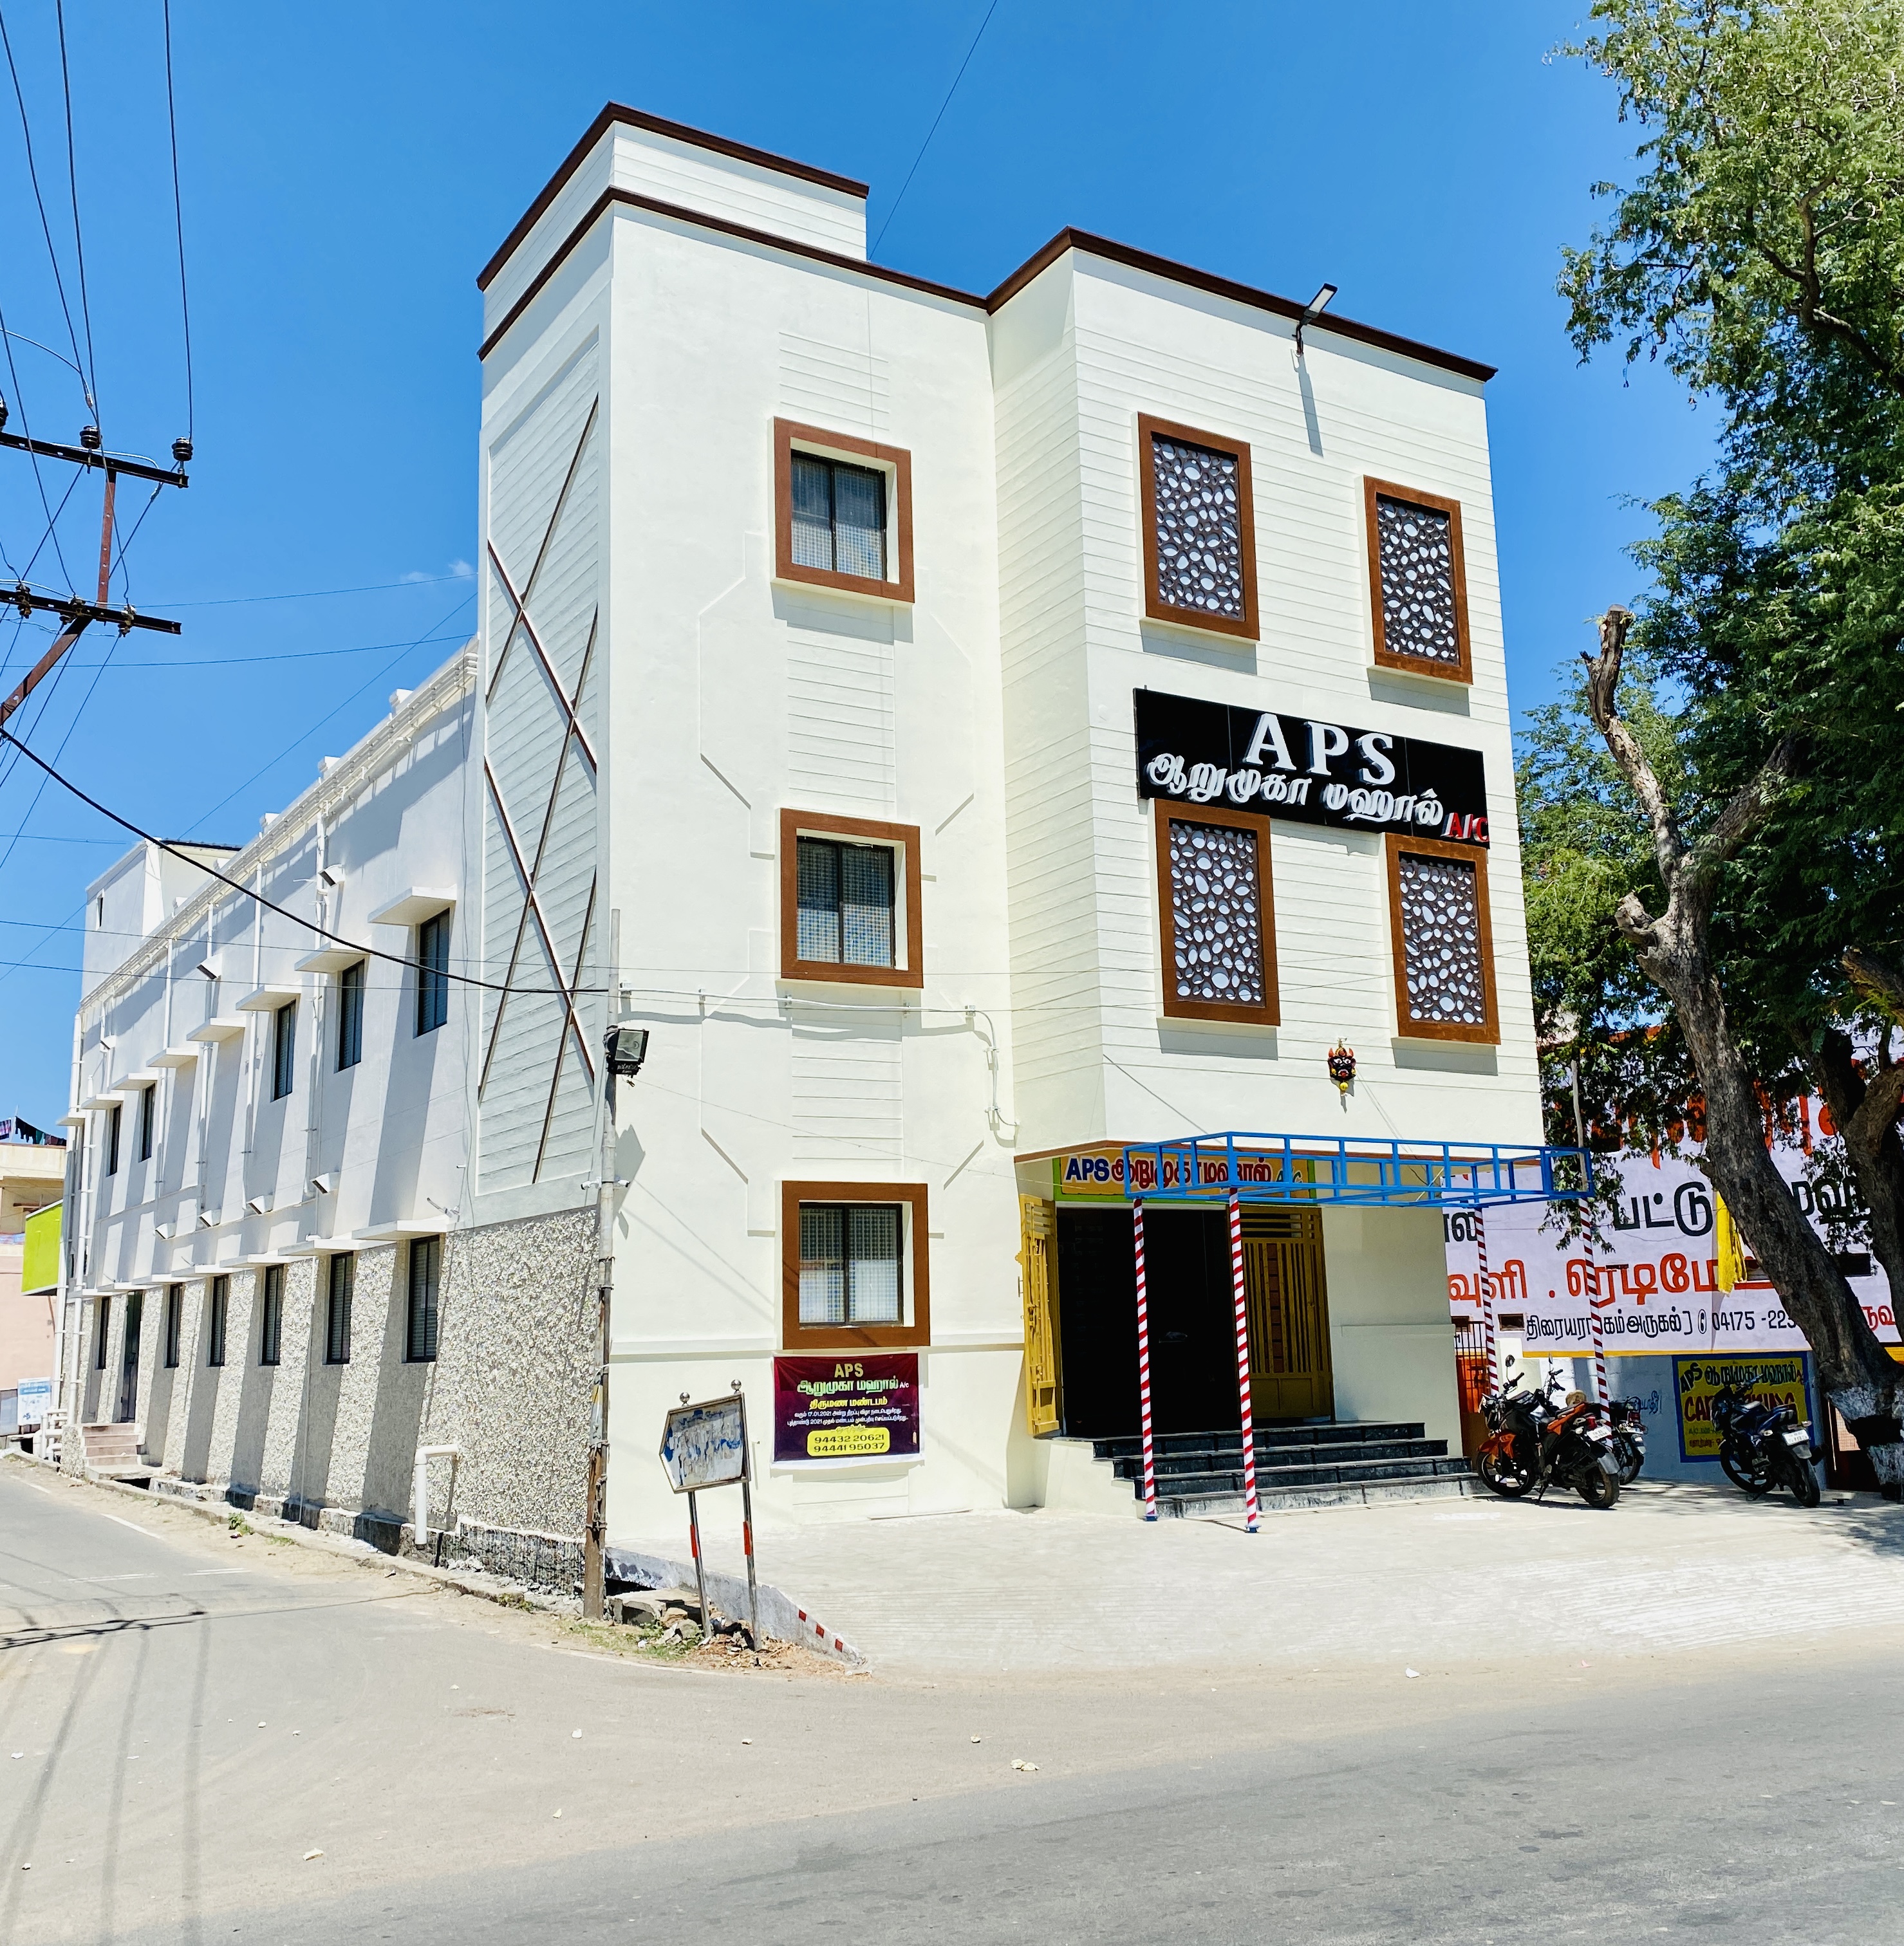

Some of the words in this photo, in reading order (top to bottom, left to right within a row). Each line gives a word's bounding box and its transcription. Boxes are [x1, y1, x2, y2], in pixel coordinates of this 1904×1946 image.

[1243, 713, 1395, 786] APS
[1146, 752, 1312, 804] ஆறுமுகா
[1323, 783, 1444, 826] மஹால்
[1441, 812, 1489, 842] A/C
[1065, 1157, 1109, 1182] APS
[1712, 1311, 1755, 1331] 04175
[834, 1362, 864, 1378] APS
[797, 1380, 855, 1396] ஆறுமுகா
[857, 1375, 899, 1395] மஹால்
[808, 1398, 848, 1411] திருமண
[849, 1396, 888, 1407] மண்டபம்
[814, 1435, 851, 1444] 94432
[853, 1433, 884, 1442] 20621
[814, 1444, 846, 1452] 94441
[849, 1442, 885, 1451] 95037
